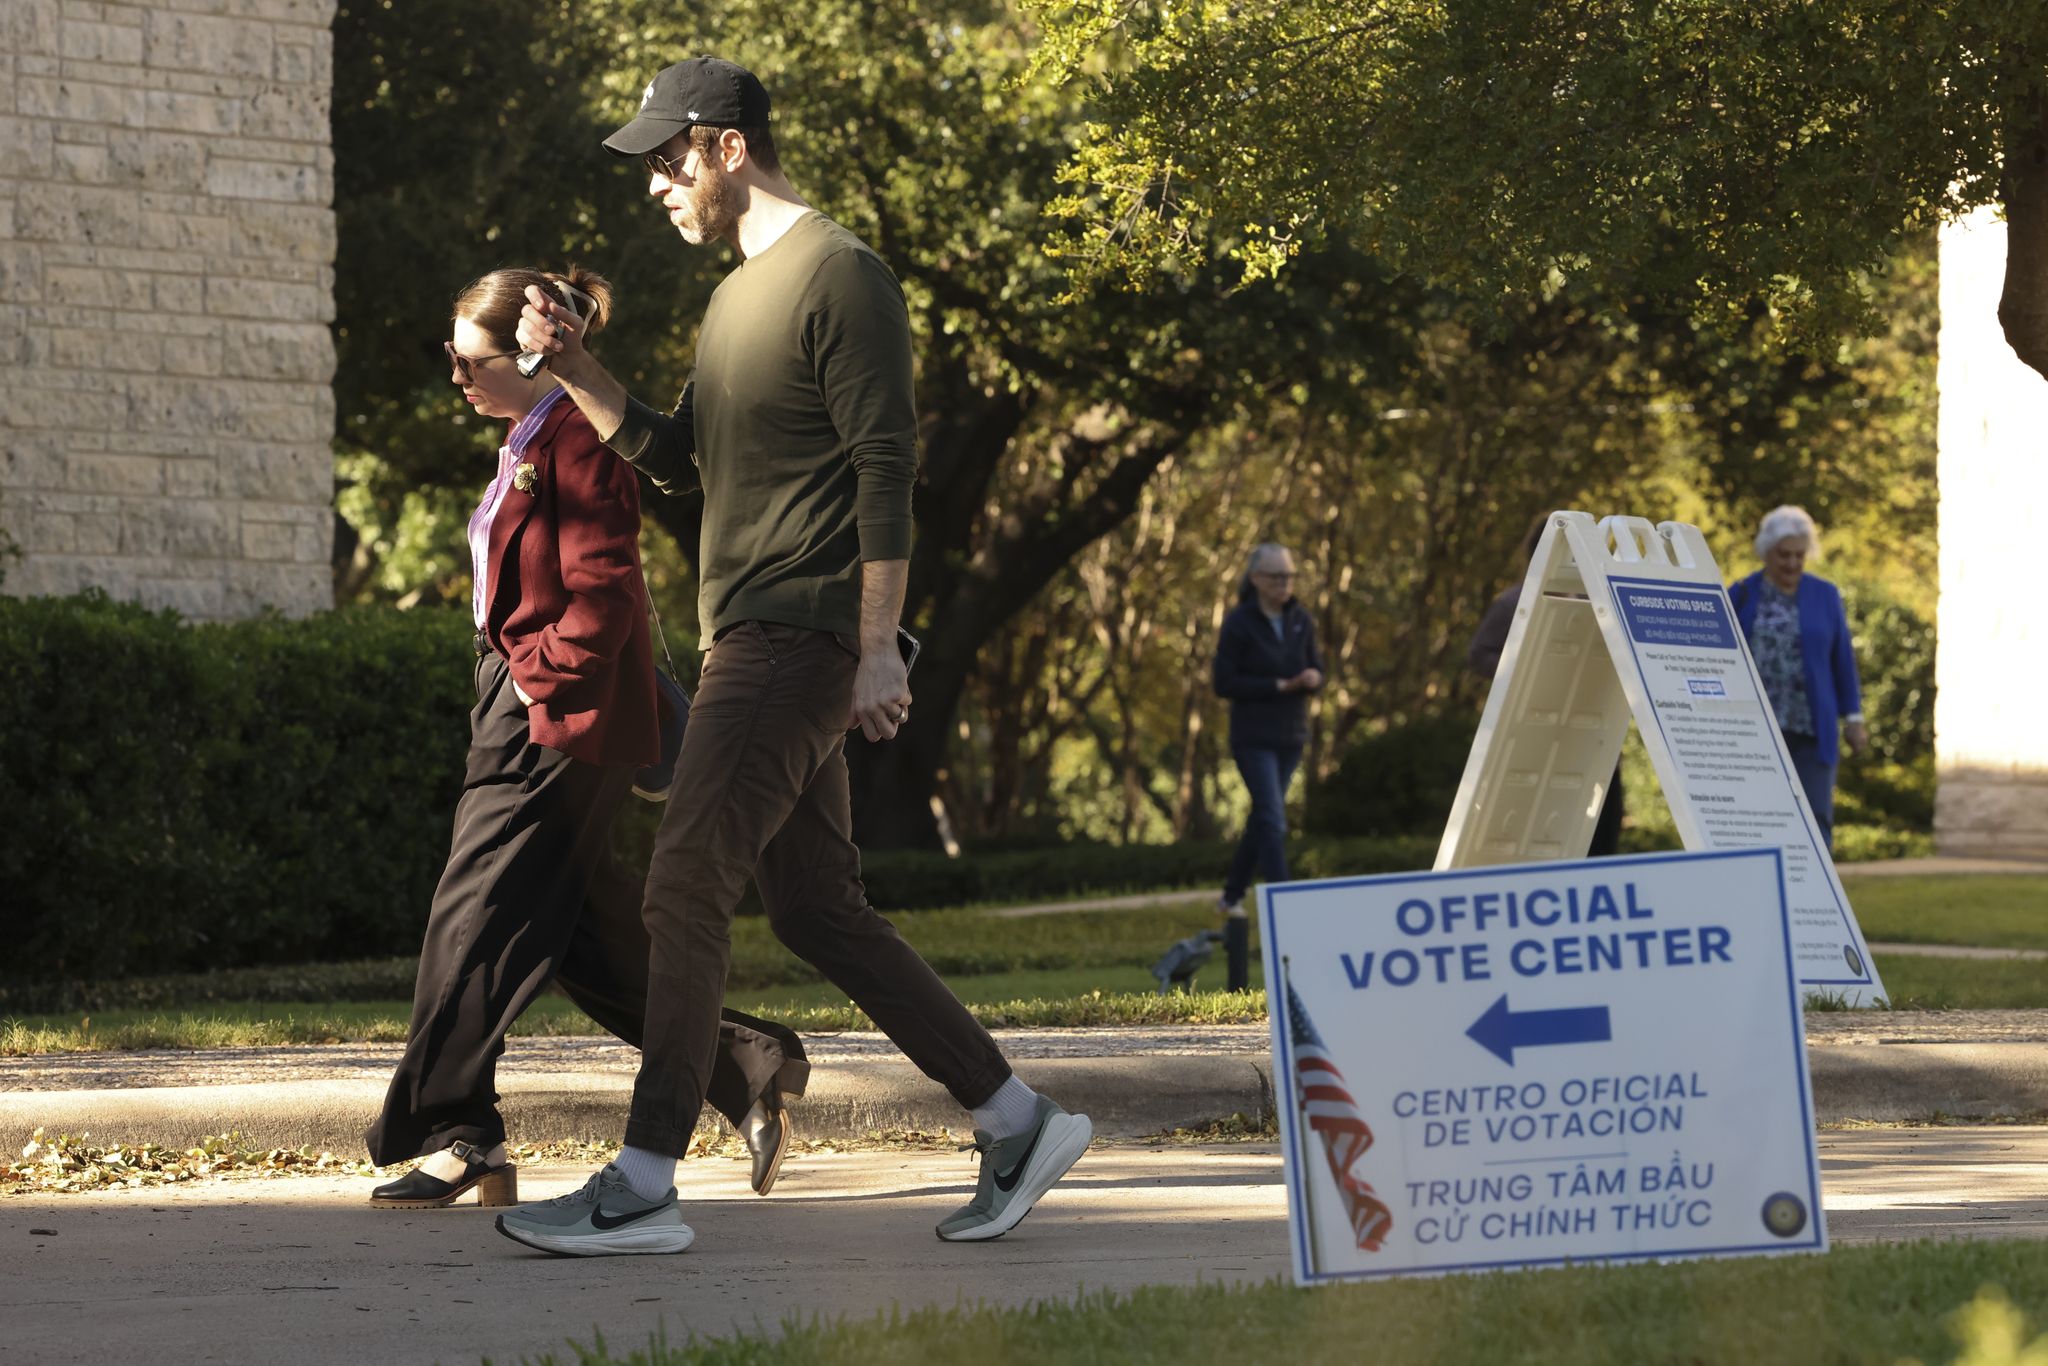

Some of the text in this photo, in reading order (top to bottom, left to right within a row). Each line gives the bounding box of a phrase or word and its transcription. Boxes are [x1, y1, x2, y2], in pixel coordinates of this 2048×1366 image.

[1629, 595, 1716, 613] CURBSIDE VOTING SPACE
[1395, 881, 1655, 938] OFFICIAL
[1339, 925, 1734, 991] VOTE CENTER
[1392, 1071, 1708, 1119] CENTRO OFICIAL
[1423, 1101, 1684, 1148] DE VOTACIÓN
[1405, 1173, 1534, 1208] TRUNG
[1546, 1162, 1627, 1199] TÂM
[1479, 1204, 1597, 1241] CHÍNH
[1610, 1194, 1712, 1232] THỨC
